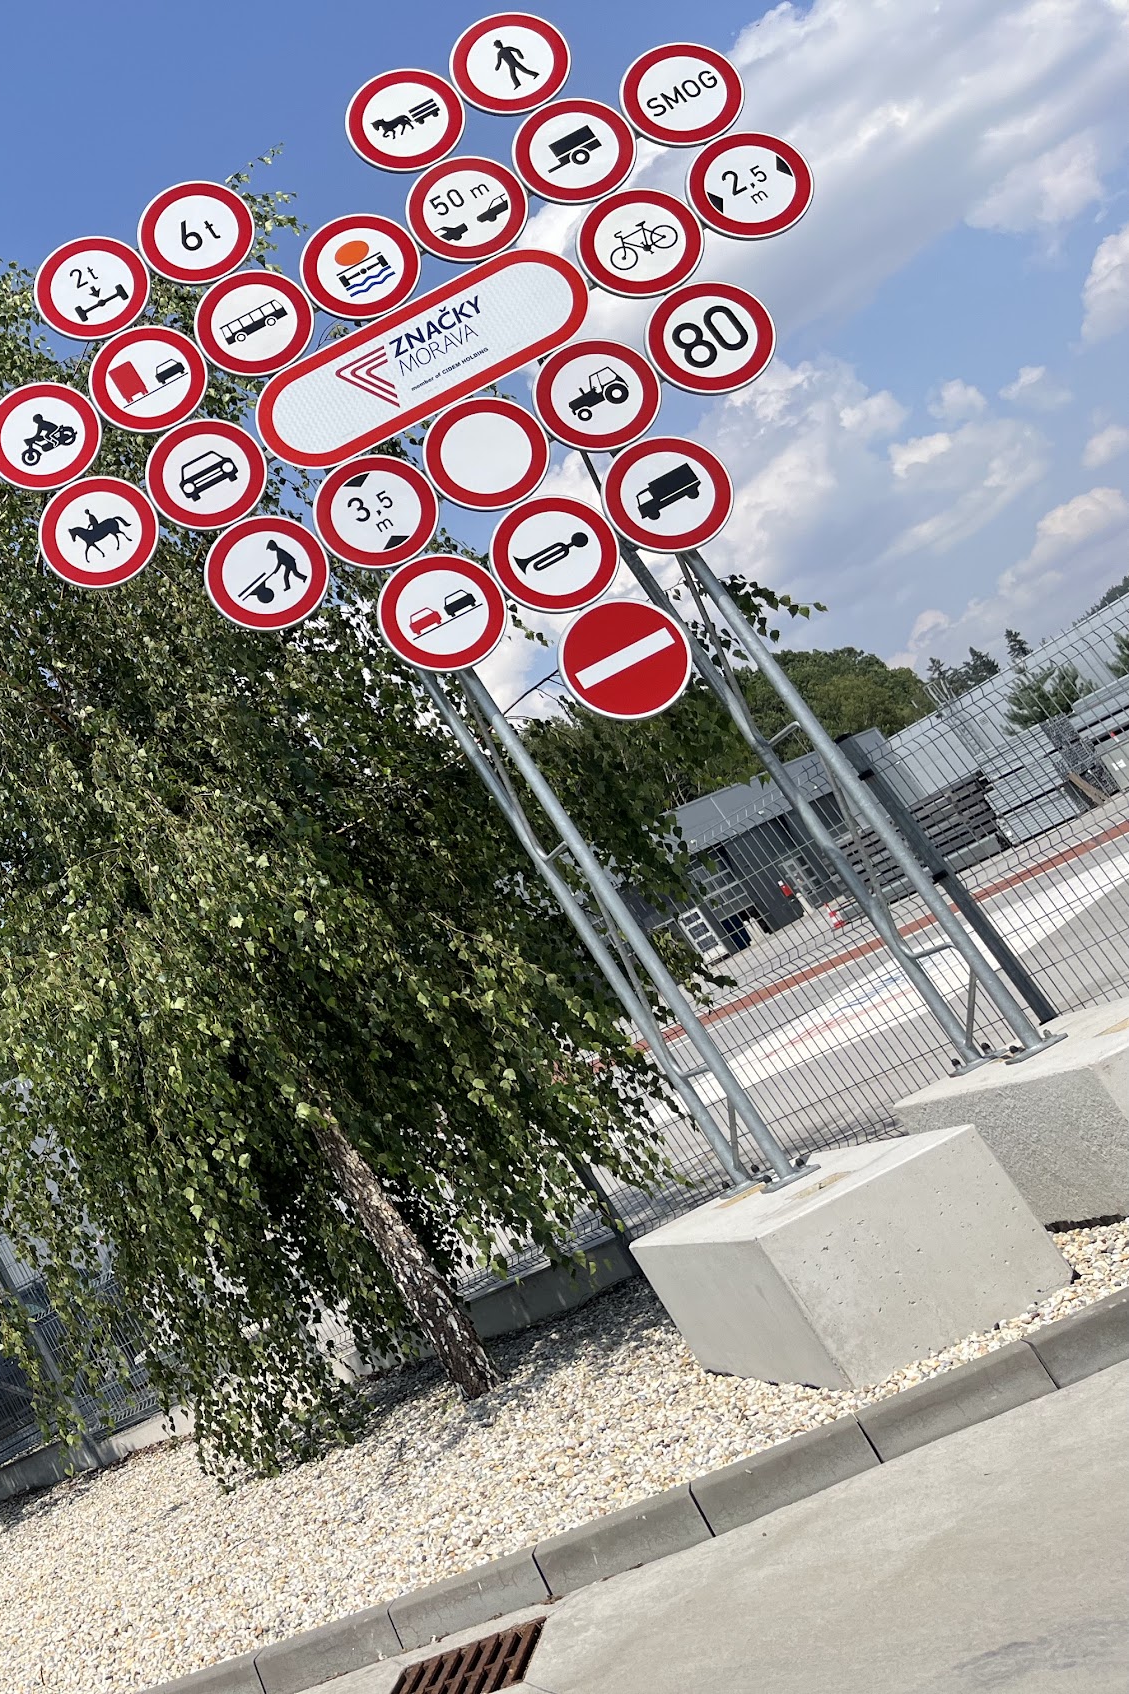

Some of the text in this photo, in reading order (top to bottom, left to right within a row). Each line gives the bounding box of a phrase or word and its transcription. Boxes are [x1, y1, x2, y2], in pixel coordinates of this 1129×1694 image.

[646, 70, 718, 117] SMOG
[429, 183, 490, 216] 50 m
[721, 165, 767, 196] 2,5
[750, 190, 769, 204] m
[389, 295, 481, 358] ZNAČKY
[672, 305, 749, 368] 80
[398, 324, 479, 376] MORAVA
[411, 376, 434, 391] member
[442, 361, 461, 375] CIDEM
[462, 347, 489, 365] HOLDING
[347, 490, 393, 522] 3,5
[375, 518, 394, 533] m
